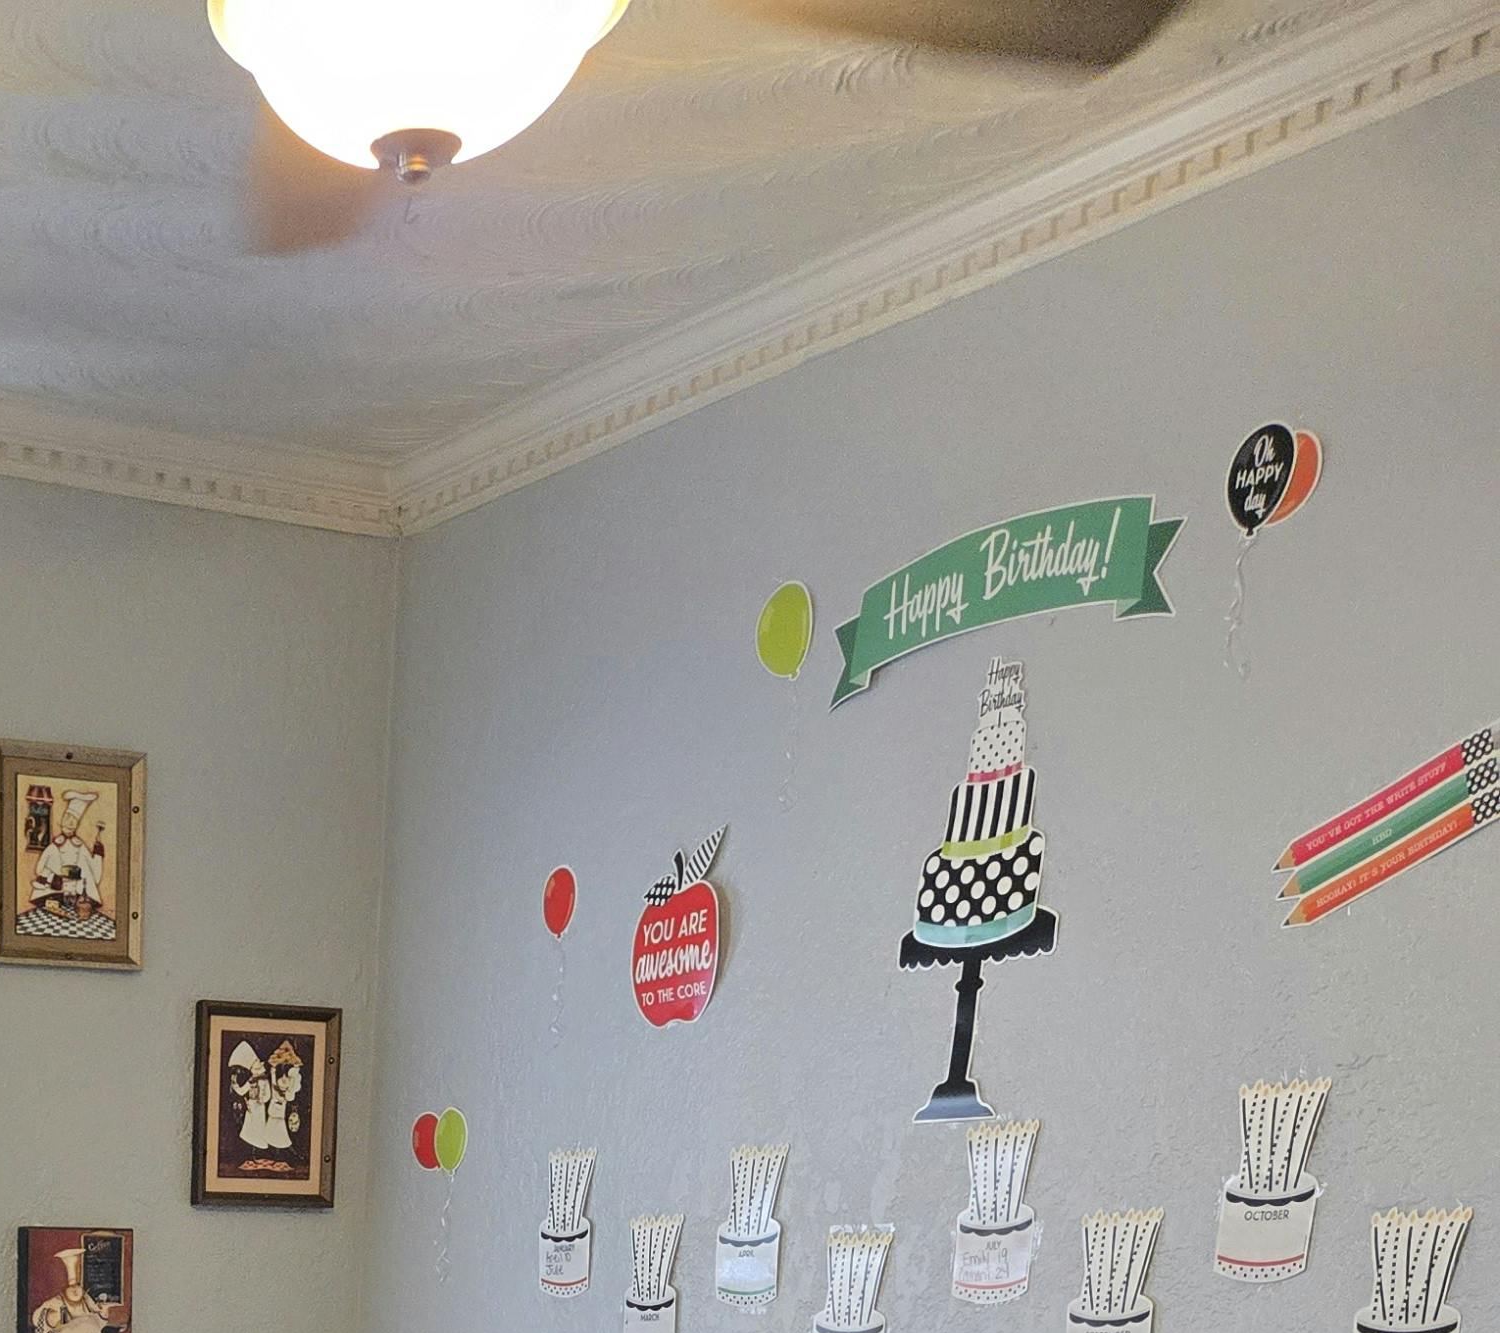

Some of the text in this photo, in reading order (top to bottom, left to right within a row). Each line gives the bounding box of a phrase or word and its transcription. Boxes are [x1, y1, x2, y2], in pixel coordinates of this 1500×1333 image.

[1253, 434, 1276, 468] Oh
[1235, 461, 1284, 490] HAPPY
[1243, 486, 1267, 519] day
[883, 506, 1121, 640] Happy Birthday!
[988, 657, 1021, 687] Happy
[979, 684, 1025, 718] Birthday
[1343, 811, 1364, 832] GOT
[1364, 800, 1385, 819] THE
[1385, 779, 1417, 805] WRITE
[1416, 761, 1448, 786] STUFF
[1380, 851, 1406, 875] YOUR
[643, 908, 708, 947] YOU ARE
[635, 939, 713, 985] awesome
[641, 981, 707, 1007] TO THE CORE
[1244, 1208, 1290, 1222] OCTOBER
[985, 1240, 1002, 1251] JULY
[639, 1313, 660, 1322] MARCH
